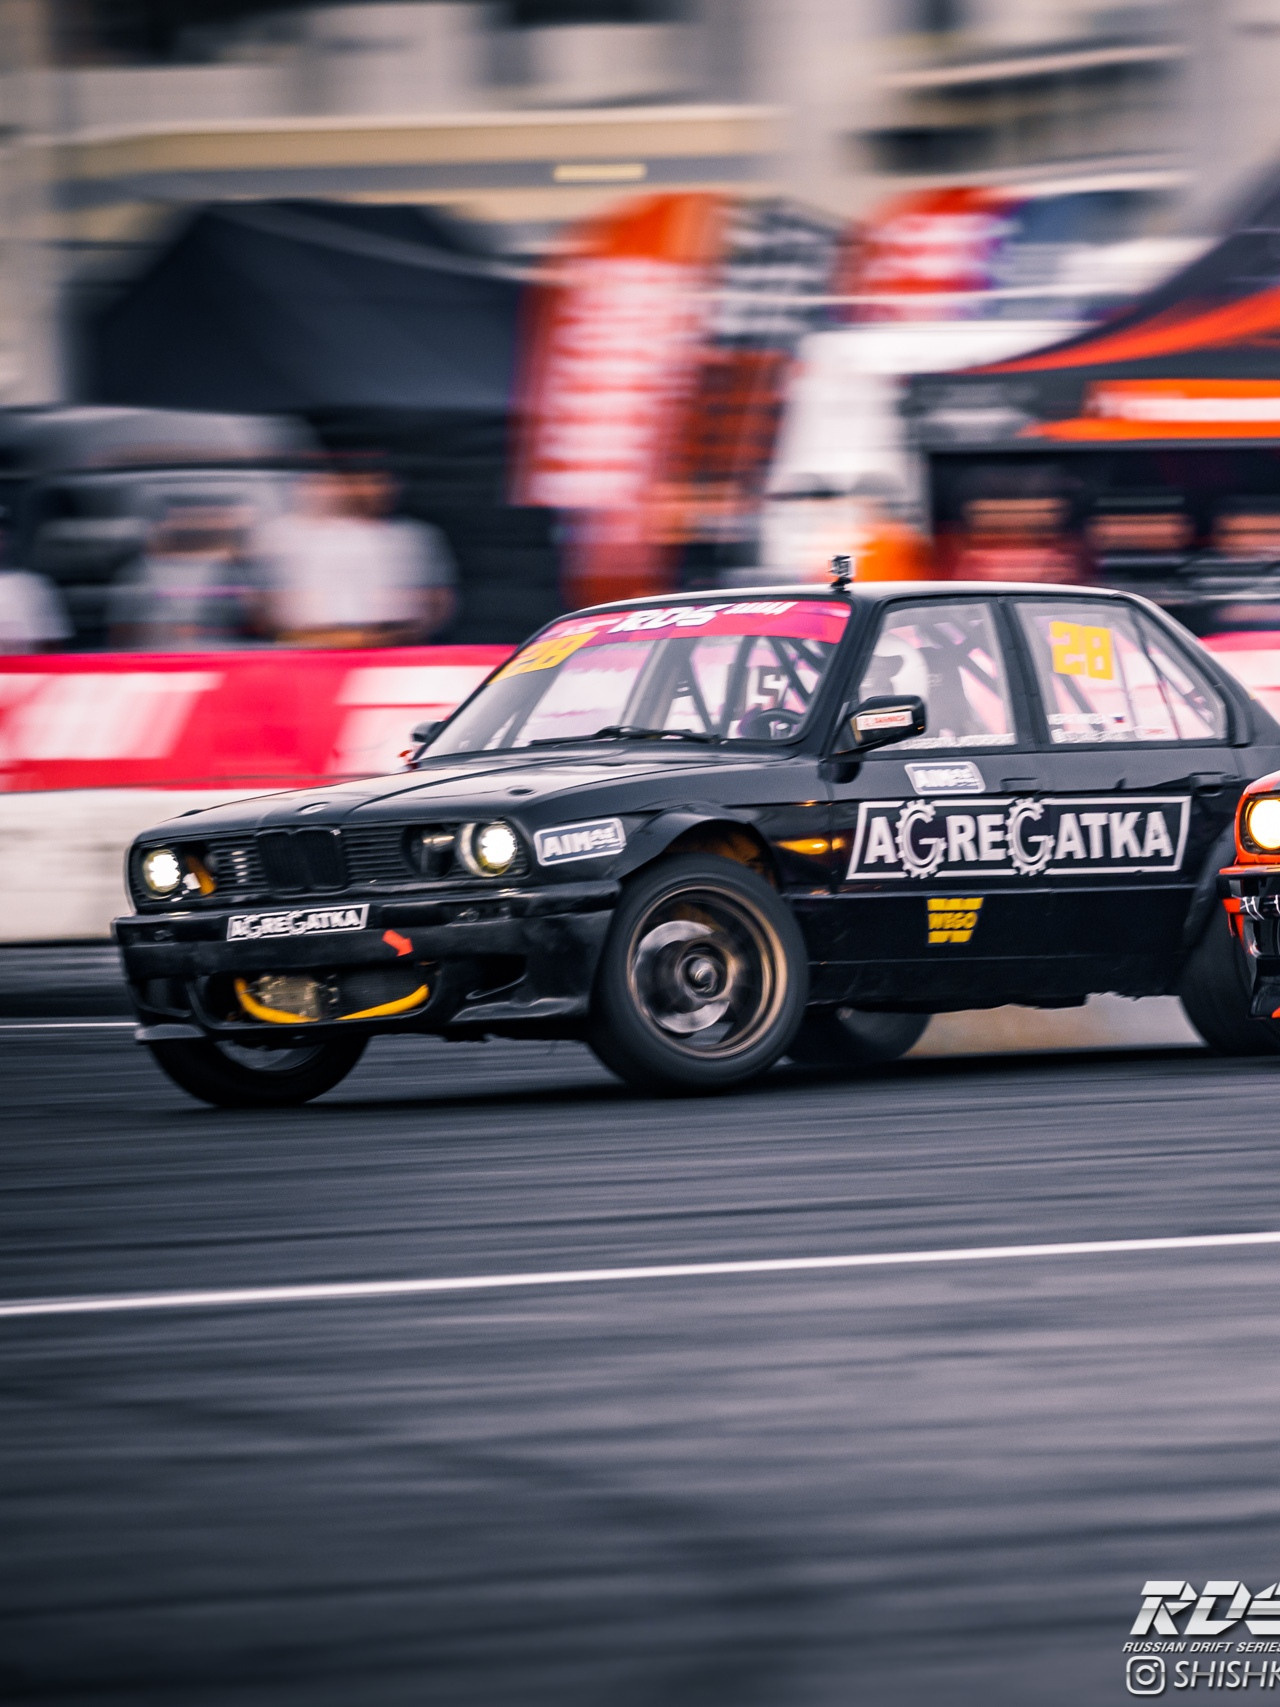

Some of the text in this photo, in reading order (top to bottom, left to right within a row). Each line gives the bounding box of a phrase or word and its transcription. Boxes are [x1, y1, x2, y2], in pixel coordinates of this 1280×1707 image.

[606, 603, 736, 634] RDS
[1048, 620, 1114, 680] 28
[864, 799, 1174, 877] AGREGATKA
